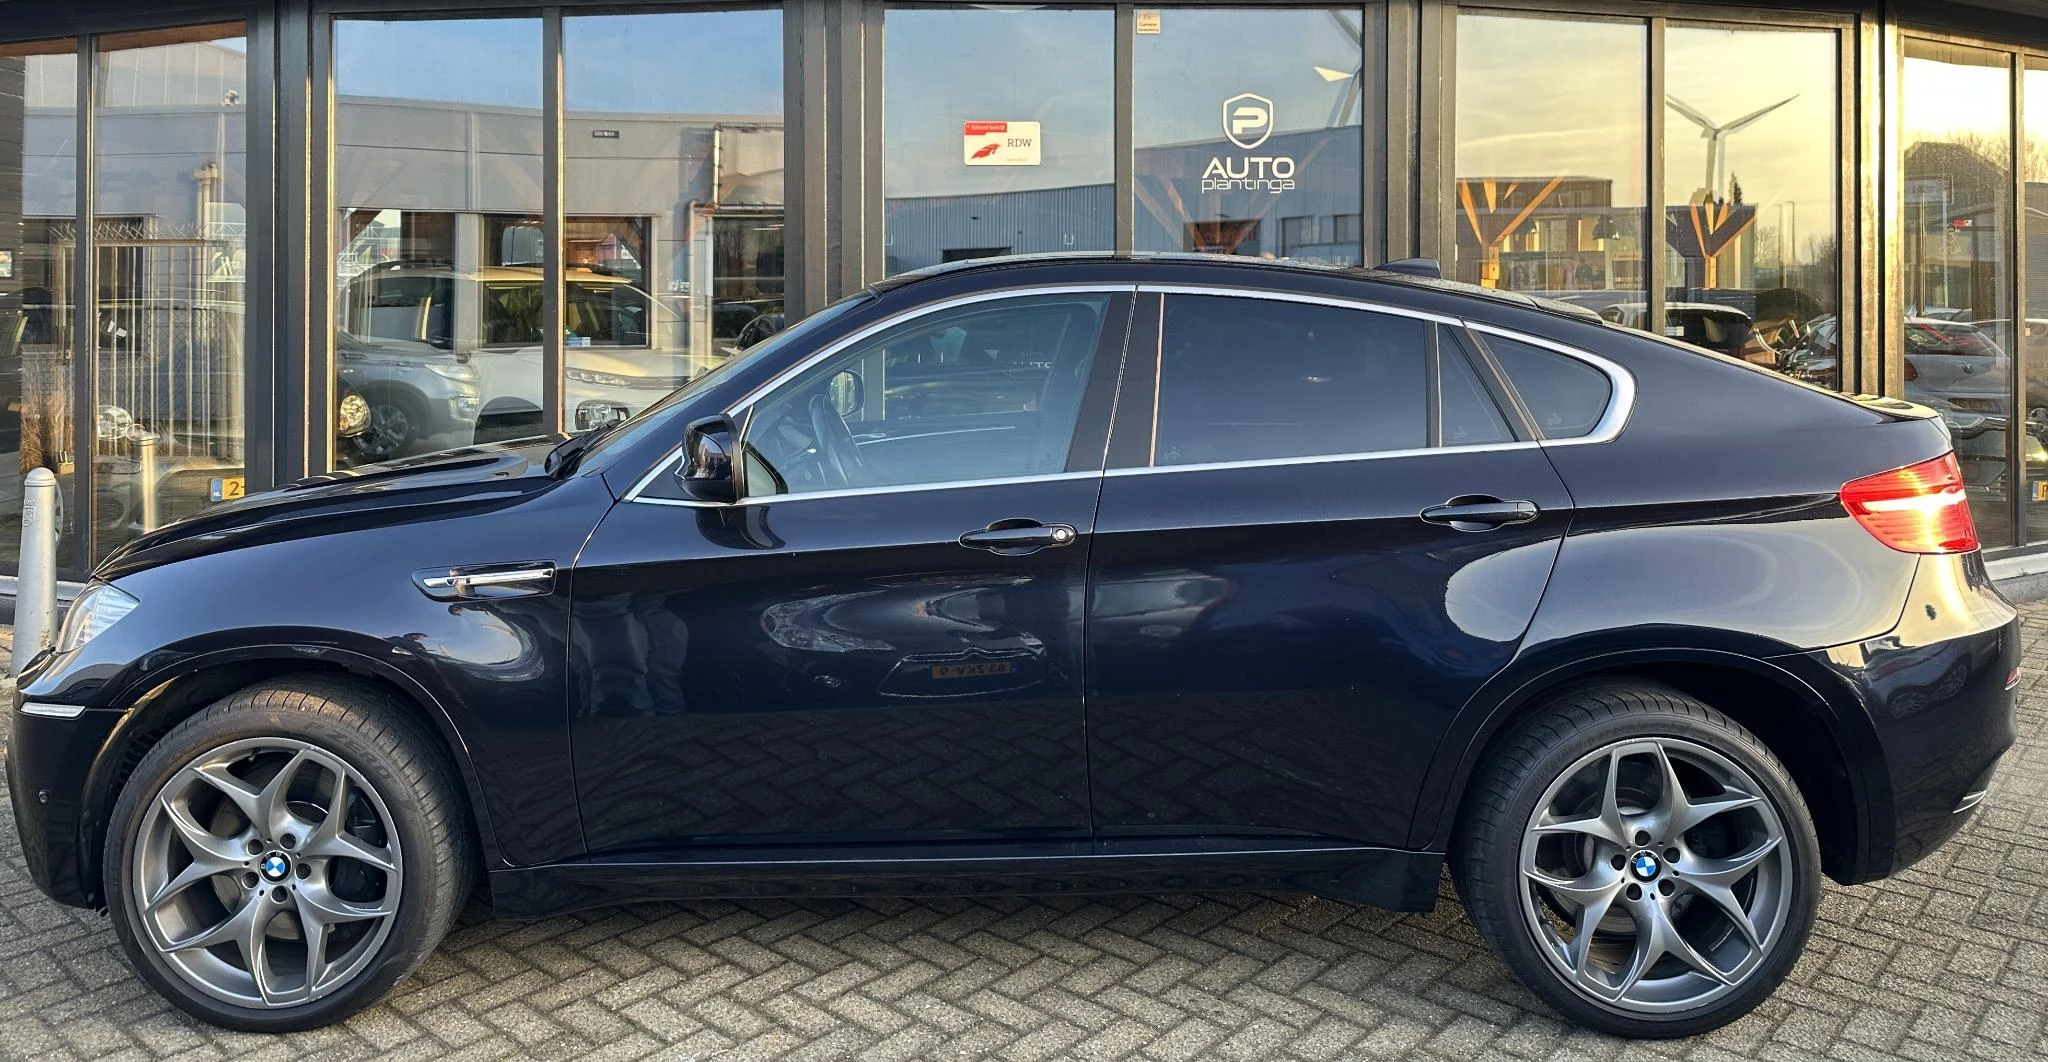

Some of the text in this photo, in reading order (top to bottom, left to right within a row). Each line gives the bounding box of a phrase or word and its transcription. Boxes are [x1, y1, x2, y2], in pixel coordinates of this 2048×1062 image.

[1007, 138, 1032, 147] RDW
[1202, 157, 1295, 178] AUTO
[1202, 177, 1295, 194] plantinga
[326, 730, 393, 780] ZERO
